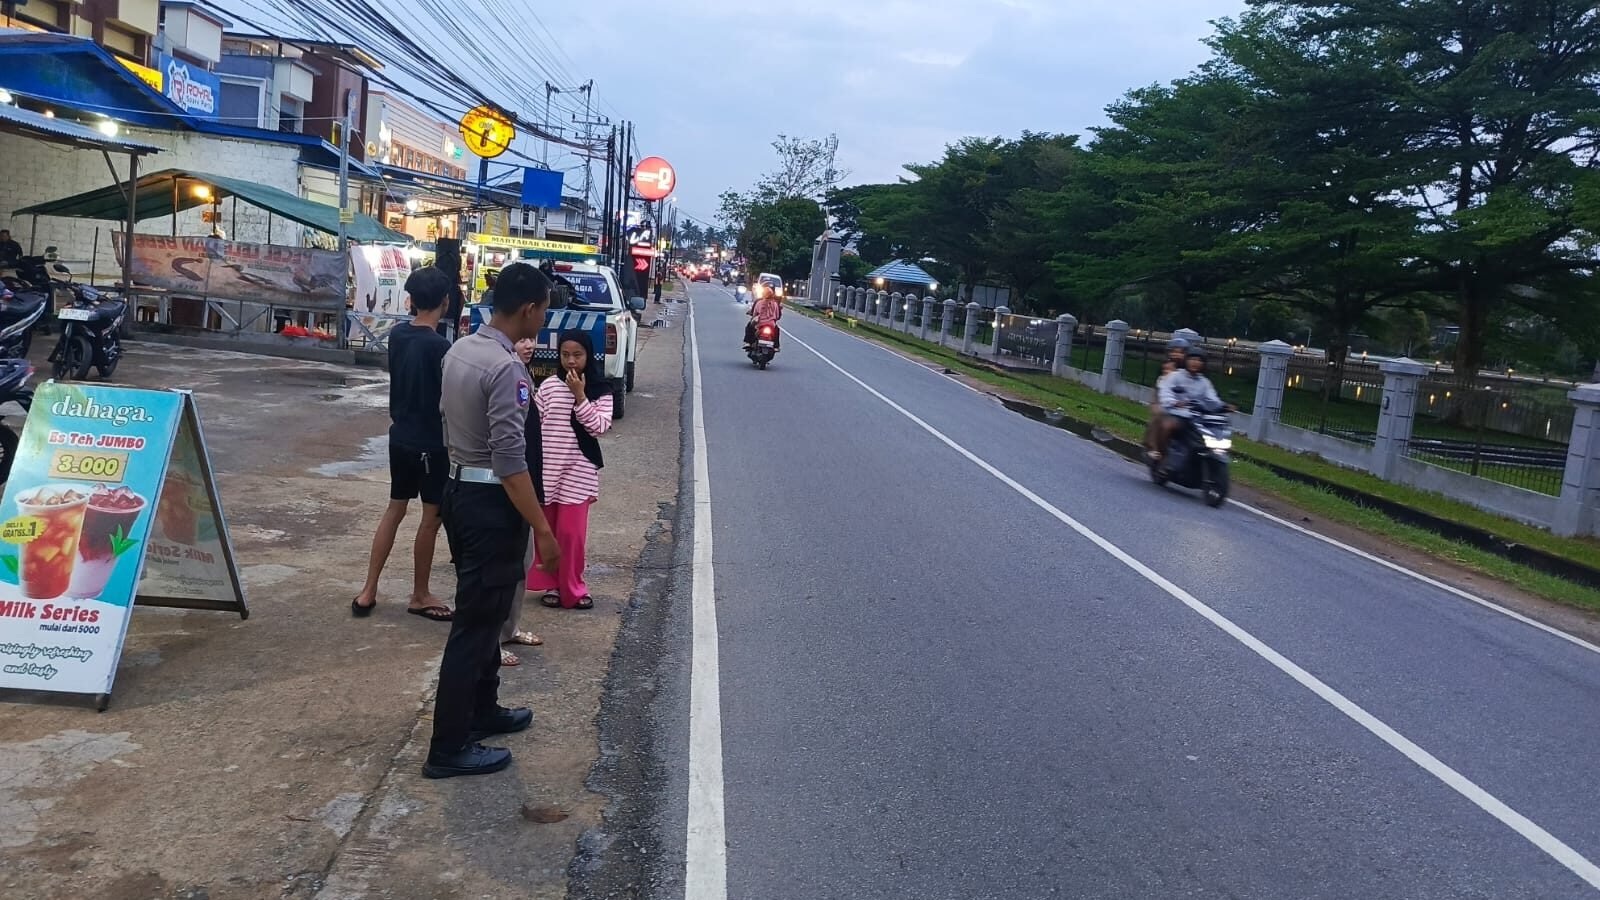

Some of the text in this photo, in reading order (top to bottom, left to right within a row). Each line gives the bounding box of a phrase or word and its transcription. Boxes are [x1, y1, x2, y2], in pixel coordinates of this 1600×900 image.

[187, 83, 211, 102] ROYAL
[70, 433, 94, 446] Teh
[96, 435, 145, 449] JUMBO
[57, 454, 120, 475] 3.000
[0, 601, 100, 622] Milk Series
[39, 623, 100, 634] mulai dari 5000
[42, 646, 93, 663] refreshing
[3, 662, 58, 680] and tasty
